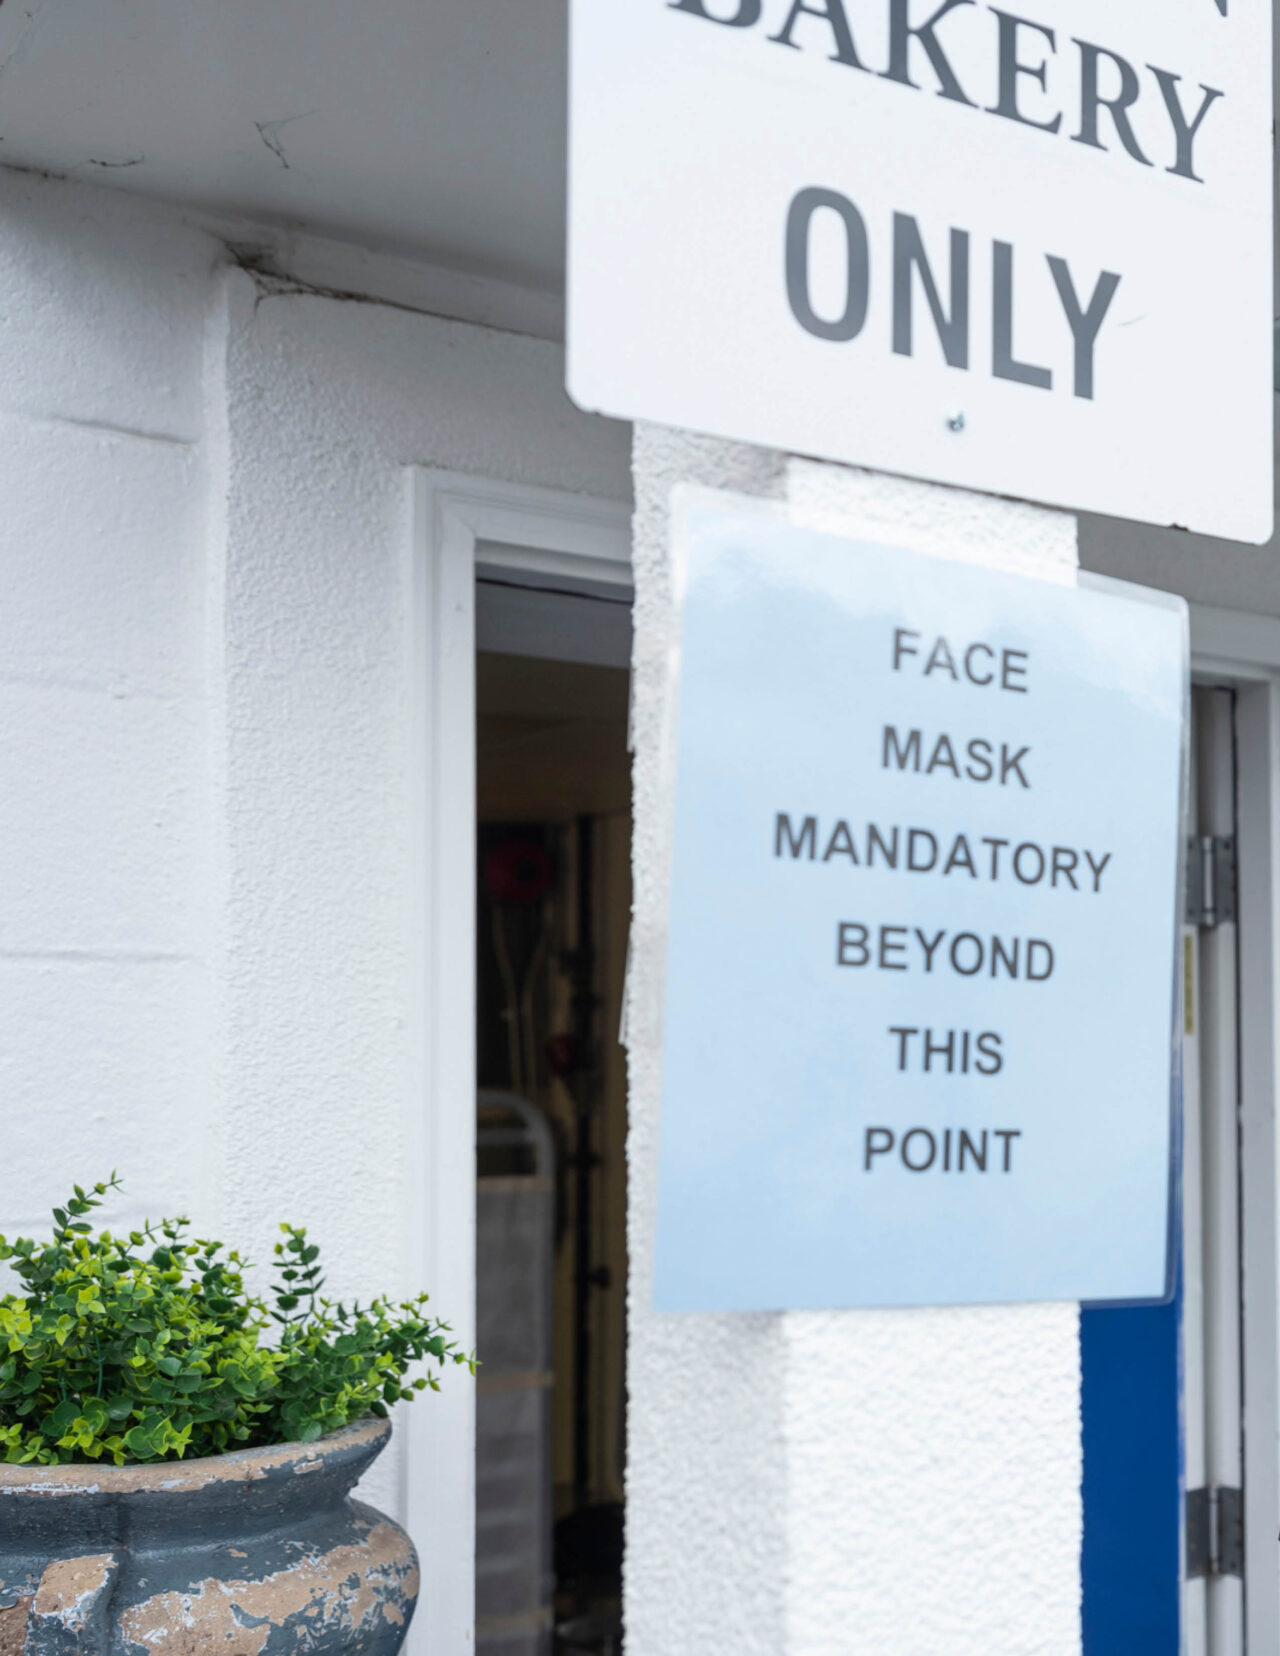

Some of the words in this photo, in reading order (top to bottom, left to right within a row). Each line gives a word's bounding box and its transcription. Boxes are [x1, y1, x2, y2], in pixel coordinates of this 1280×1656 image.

[784, 186, 1122, 401] ONLY
[891, 628, 1030, 693] FACE
[881, 725, 1031, 789] MASK
[773, 812, 1112, 893] MANDATORY
[836, 921, 1056, 982] BEYOND
[888, 1026, 1004, 1076] THIS
[863, 1126, 1022, 1173] POINT
